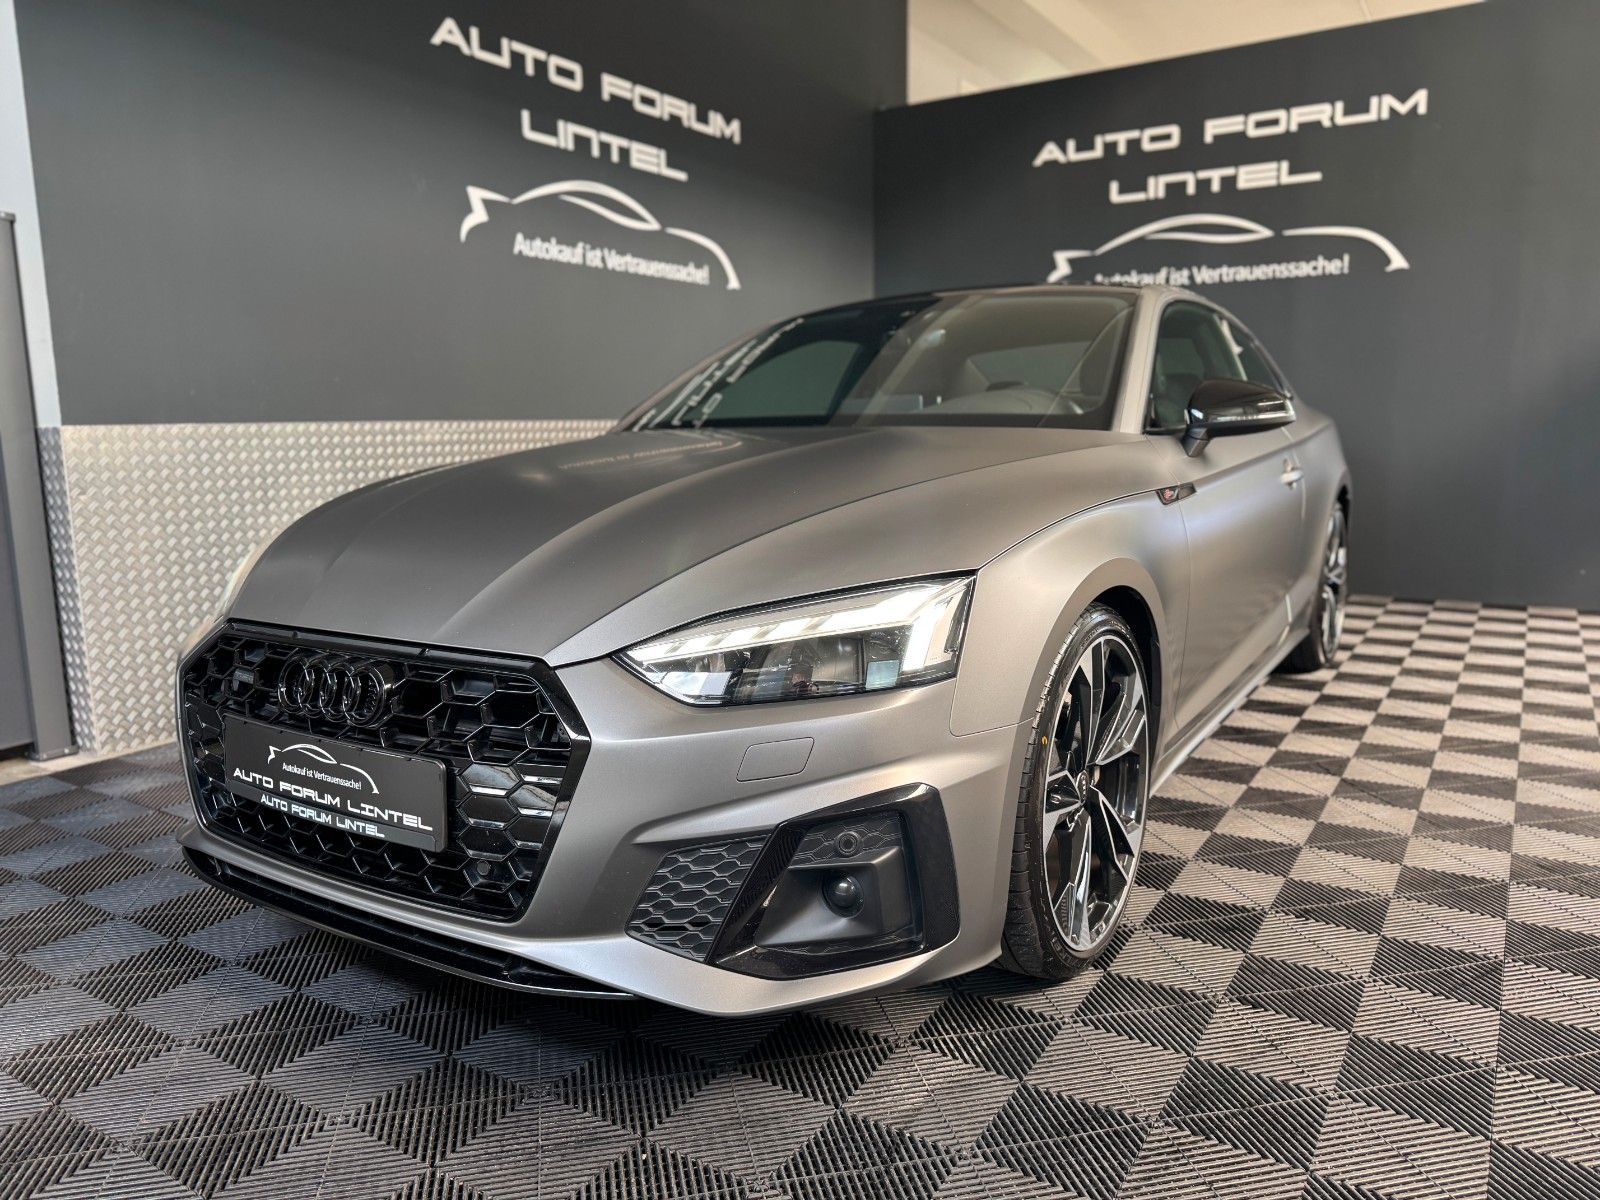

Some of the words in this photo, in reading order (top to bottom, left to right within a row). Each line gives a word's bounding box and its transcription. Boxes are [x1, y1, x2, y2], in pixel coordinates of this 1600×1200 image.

[430, 17, 583, 92] AUTO
[600, 72, 741, 145] FORUM
[520, 109, 688, 182] LINTEL
[1032, 124, 1181, 167] AUTO
[1204, 88, 1429, 144] FORUM
[1109, 159, 1323, 204] LINTEL
[513, 232, 584, 265] Autokauf
[586, 243, 604, 269] ist
[603, 247, 710, 286] Vertrauenssache!
[1169, 265, 1190, 286] ist
[1191, 252, 1350, 286] Vertrauenssache!
[232, 767, 274, 789] AUTO
[279, 780, 341, 808] FORUM
[347, 799, 434, 832] LINTEL
[282, 762, 306, 776] Autokauf
[306, 768, 314, 778] ist
[314, 769, 362, 790] Vertrauenssache!
[260, 793, 289, 812] AUTO
[291, 803, 332, 825] FORUM
[336, 816, 386, 839] LINTEL
